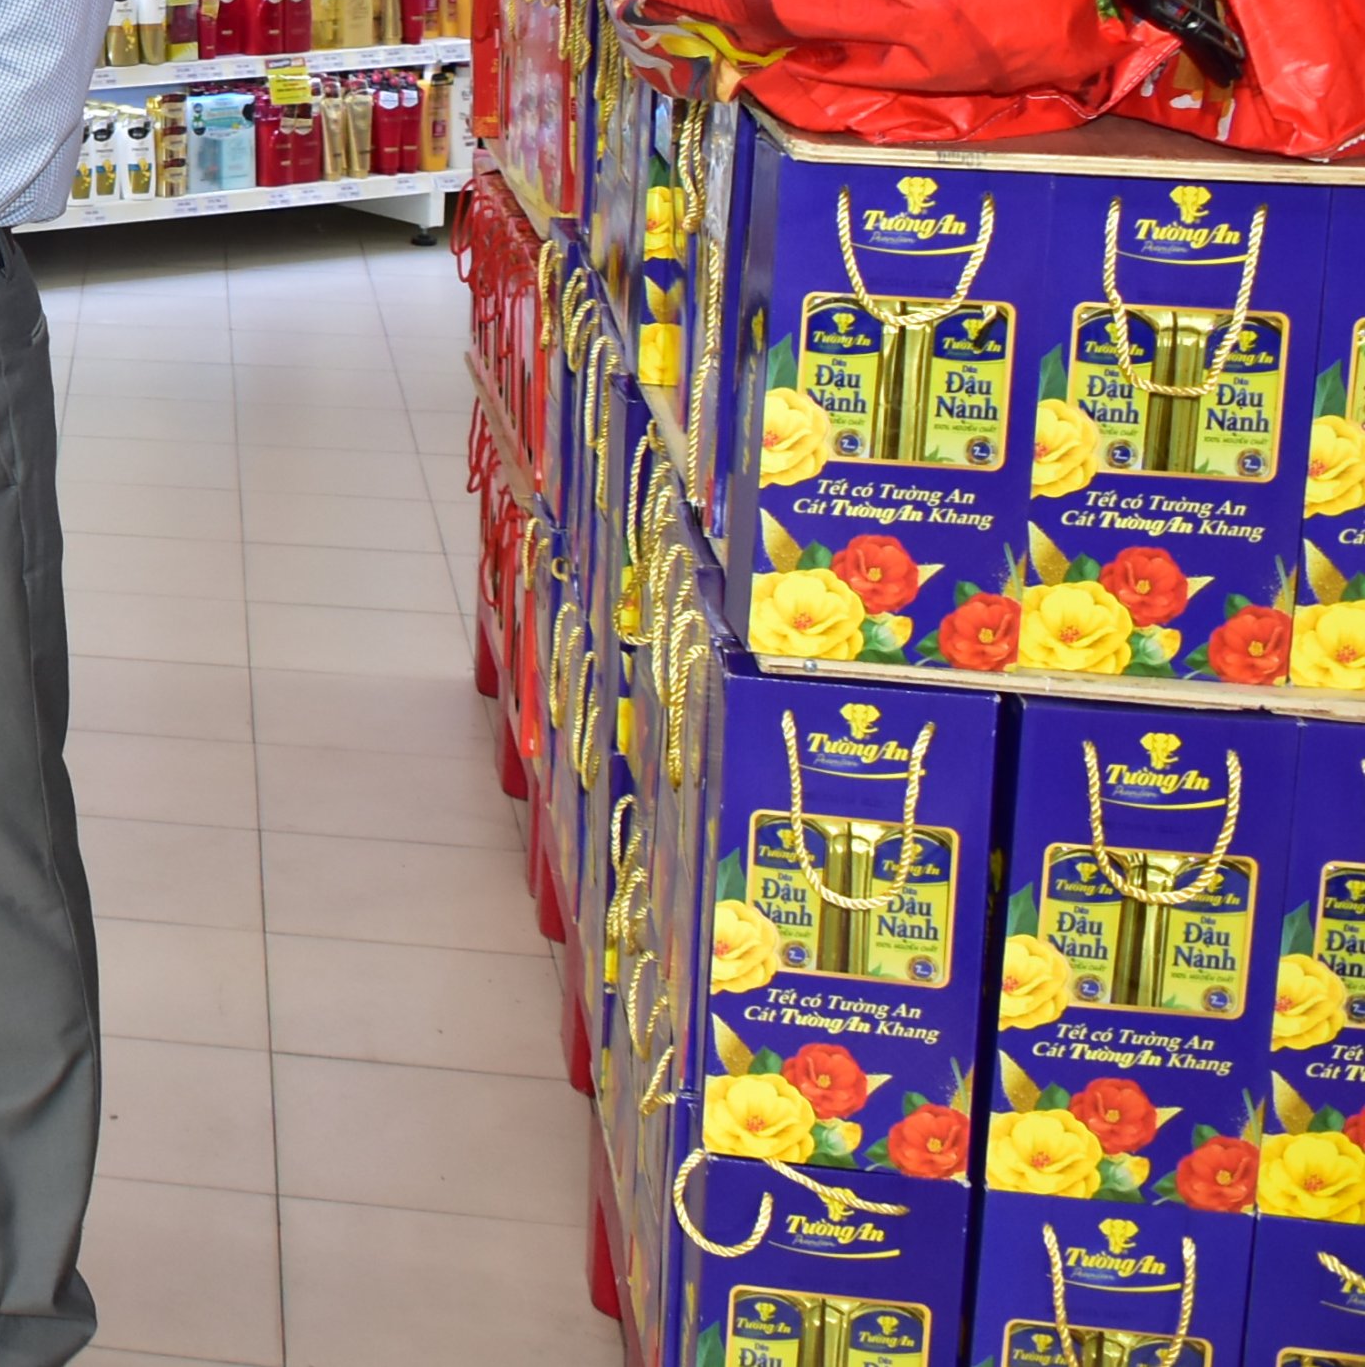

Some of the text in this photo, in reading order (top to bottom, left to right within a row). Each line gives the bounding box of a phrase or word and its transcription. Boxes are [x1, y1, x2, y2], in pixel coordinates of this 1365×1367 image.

[815, 364, 861, 392] Đậu
[945, 371, 992, 399] Đậu
[1087, 375, 1134, 403] Đậu
[935, 396, 999, 421] Nành
[1216, 384, 1264, 412] Đậu
[1205, 408, 1269, 434] Nành
[817, 478, 976, 507] Tết có Tường An
[1086, 490, 1247, 518] Tết có Tường An
[793, 498, 829, 514] Cát
[927, 507, 994, 531] Khang
[1061, 510, 1096, 527] Cát
[1197, 519, 1265, 543] Khang
[762, 878, 806, 907] Đậu
[886, 893, 932, 918] Đậu
[876, 915, 939, 941] Nành
[1057, 911, 1103, 939] Đậu
[1184, 922, 1230, 950] Đậu
[1173, 945, 1236, 971] Nành
[767, 988, 922, 1019] Tết có Tường An
[744, 1005, 777, 1022] Cát
[875, 1020, 940, 1044] Khang
[1057, 1023, 1215, 1052] Tết có Tường An
[1032, 1041, 1066, 1058] Cát
[1166, 1053, 1233, 1076] Khang
[1332, 1044, 1365, 1062] Tết
[1306, 1062, 1341, 1080] Cát
